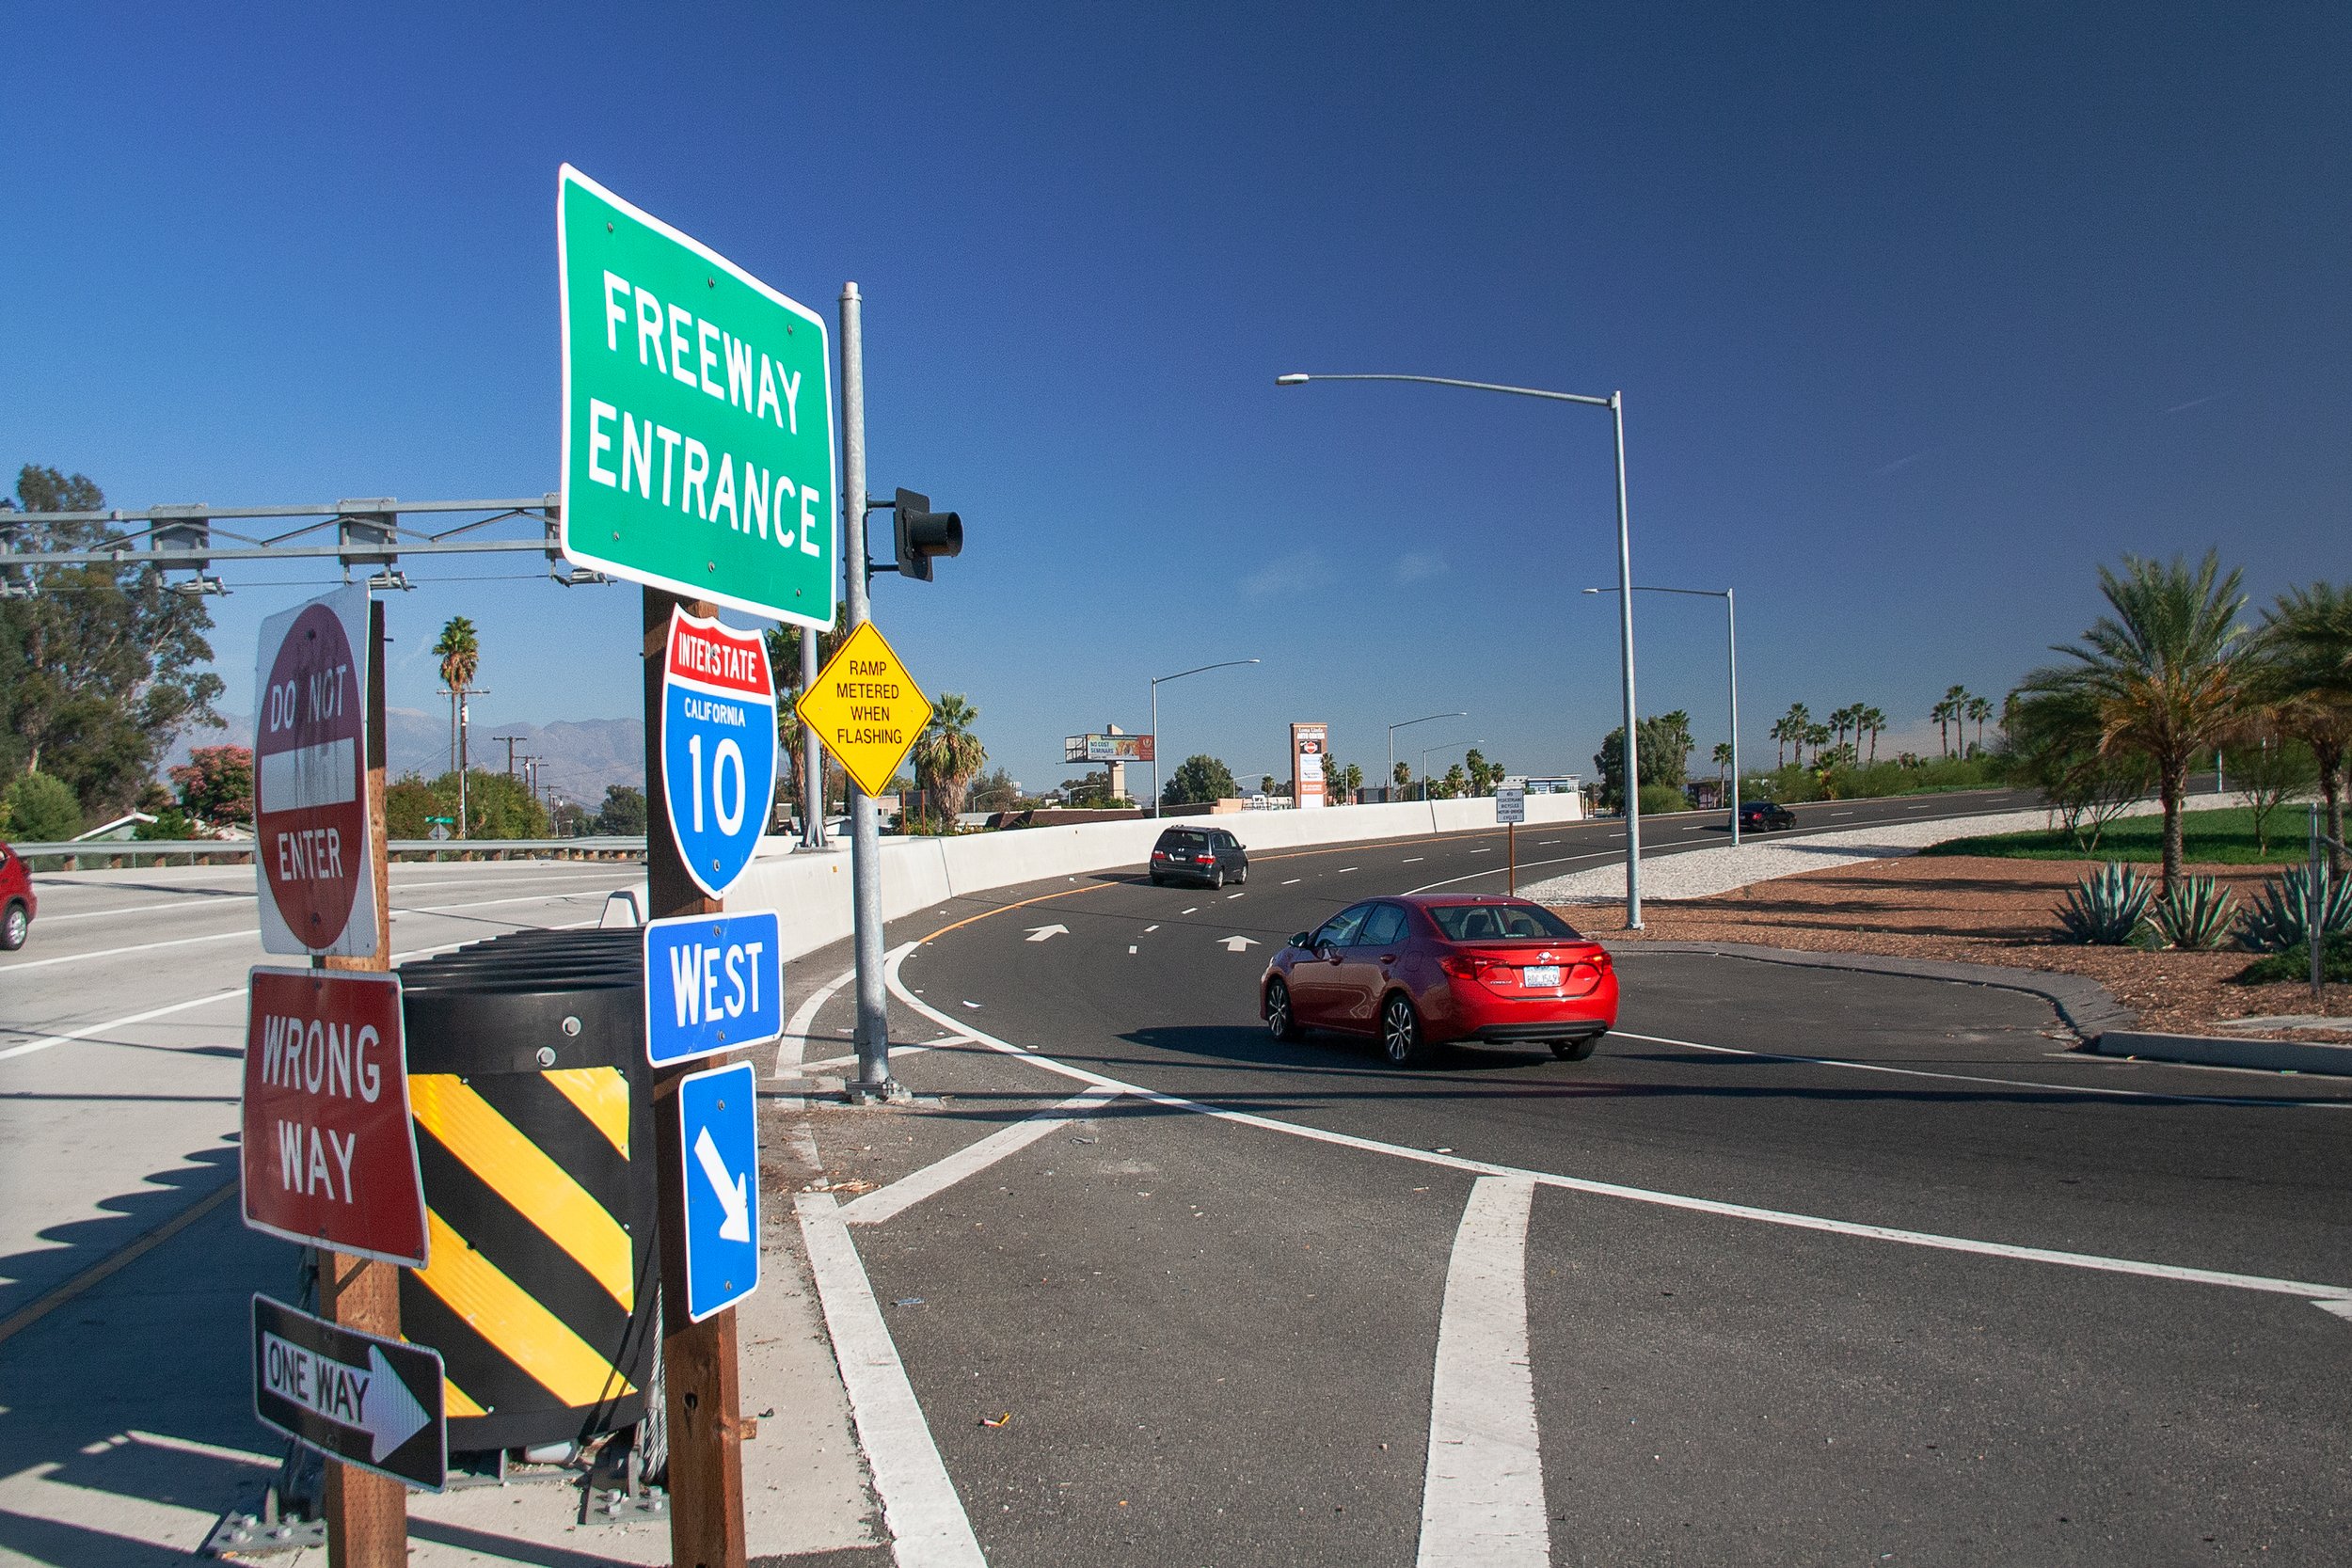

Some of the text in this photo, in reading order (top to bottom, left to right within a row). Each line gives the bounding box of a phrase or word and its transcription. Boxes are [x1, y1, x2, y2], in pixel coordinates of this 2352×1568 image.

[603, 269, 801, 435] FREEWAY
[589, 397, 820, 558] ENTRANCE
[678, 631, 757, 683] INTERSTATE
[836, 683, 899, 699] METERED
[850, 660, 887, 676] RAMP
[271, 665, 347, 733] DO NOT
[684, 697, 746, 727] CALIFORNIA
[850, 706, 890, 721] WHEN
[837, 729, 902, 744] FLASHING
[689, 734, 746, 836] 10
[278, 828, 343, 881] ENTER
[670, 942, 763, 1027] WEST
[262, 1014, 381, 1103] WRONG
[279, 1119, 356, 1204] WAY
[268, 1341, 371, 1424] ONE WAY
